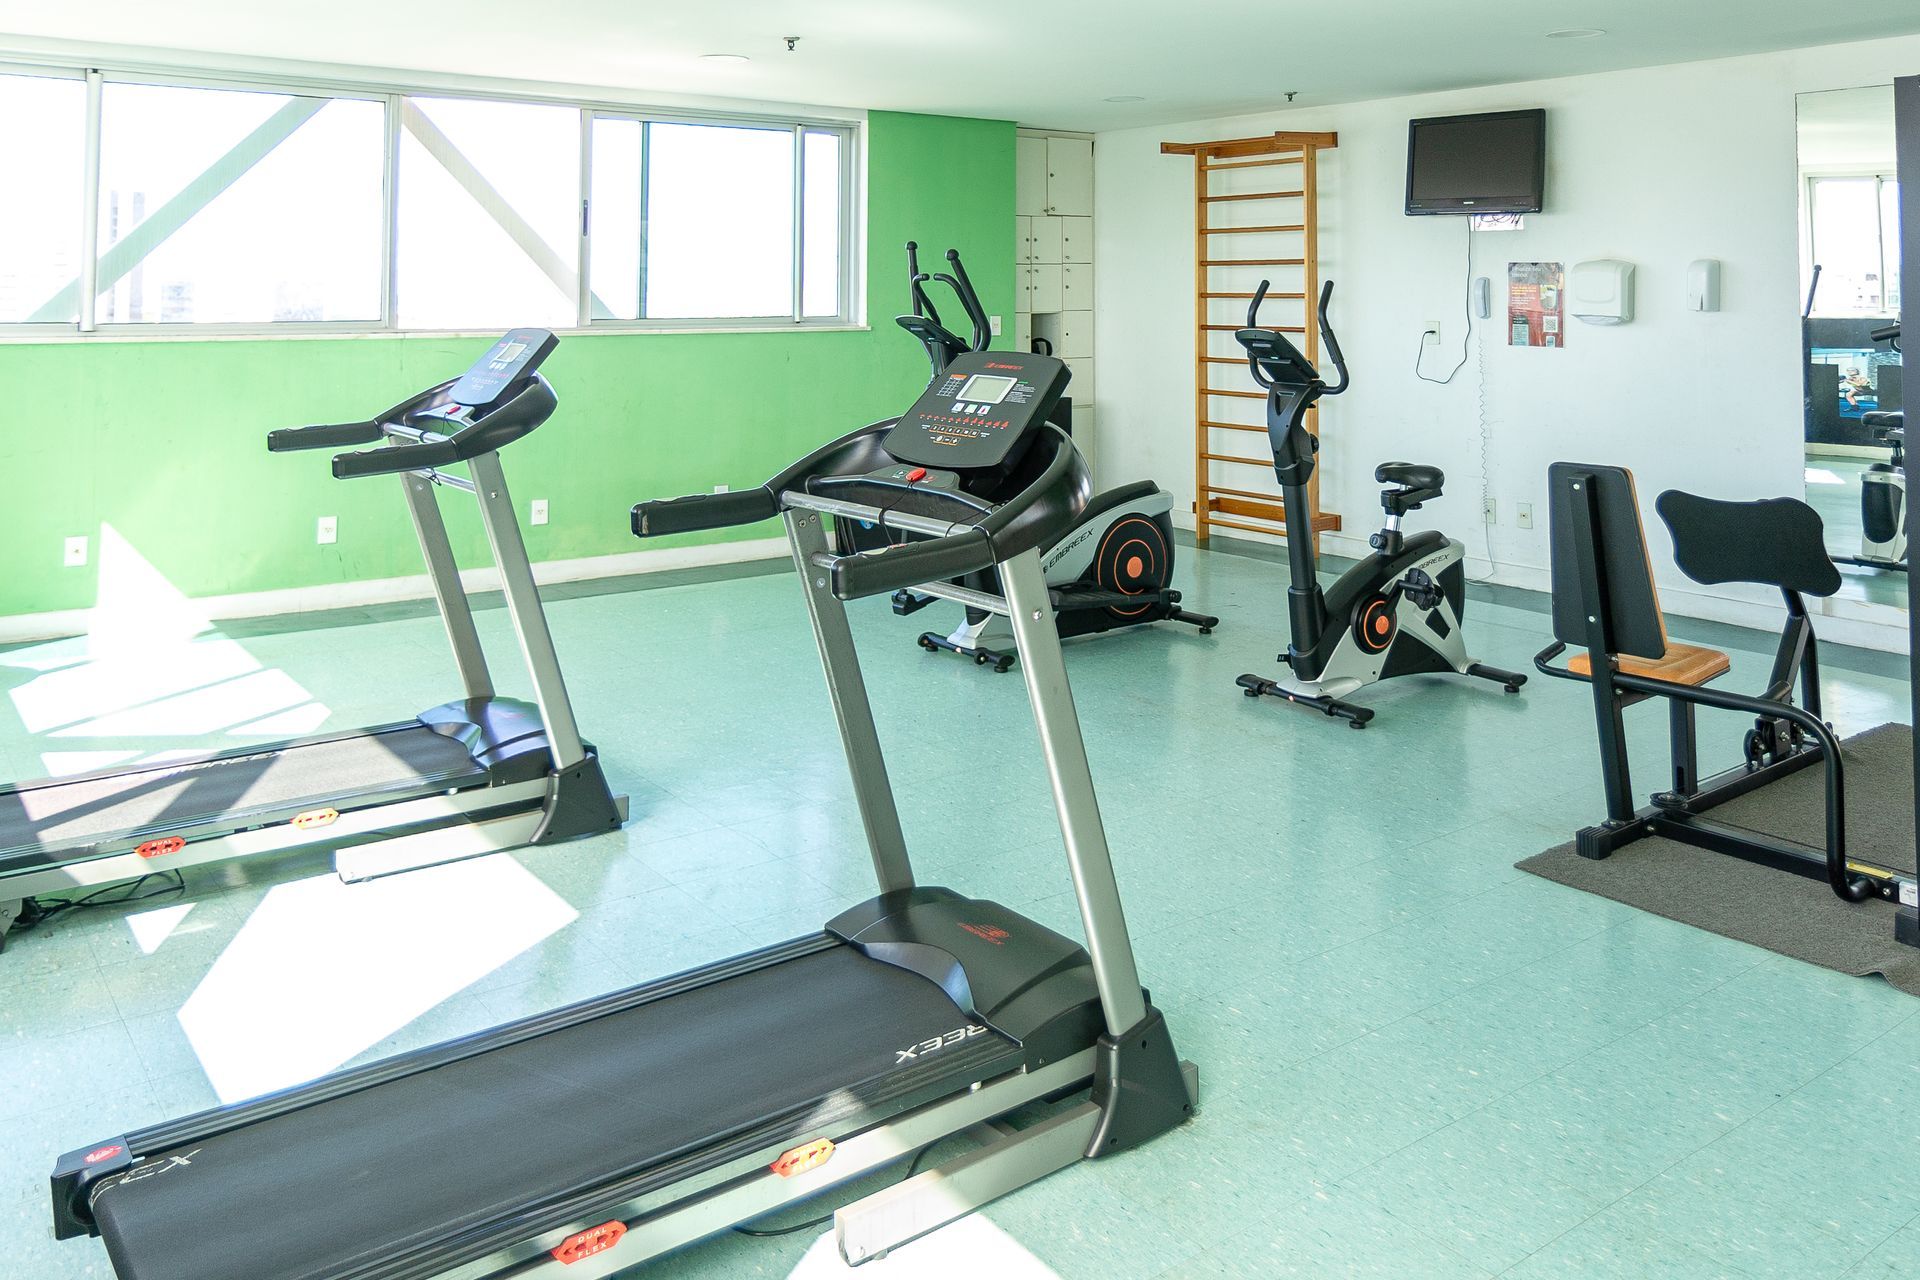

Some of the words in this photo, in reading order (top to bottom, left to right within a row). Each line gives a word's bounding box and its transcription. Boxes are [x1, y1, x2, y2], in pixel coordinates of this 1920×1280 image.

[1049, 528, 1094, 568] EMBREEX
[577, 1227, 607, 1244] DUAL
[577, 1241, 607, 1259] FLEX
